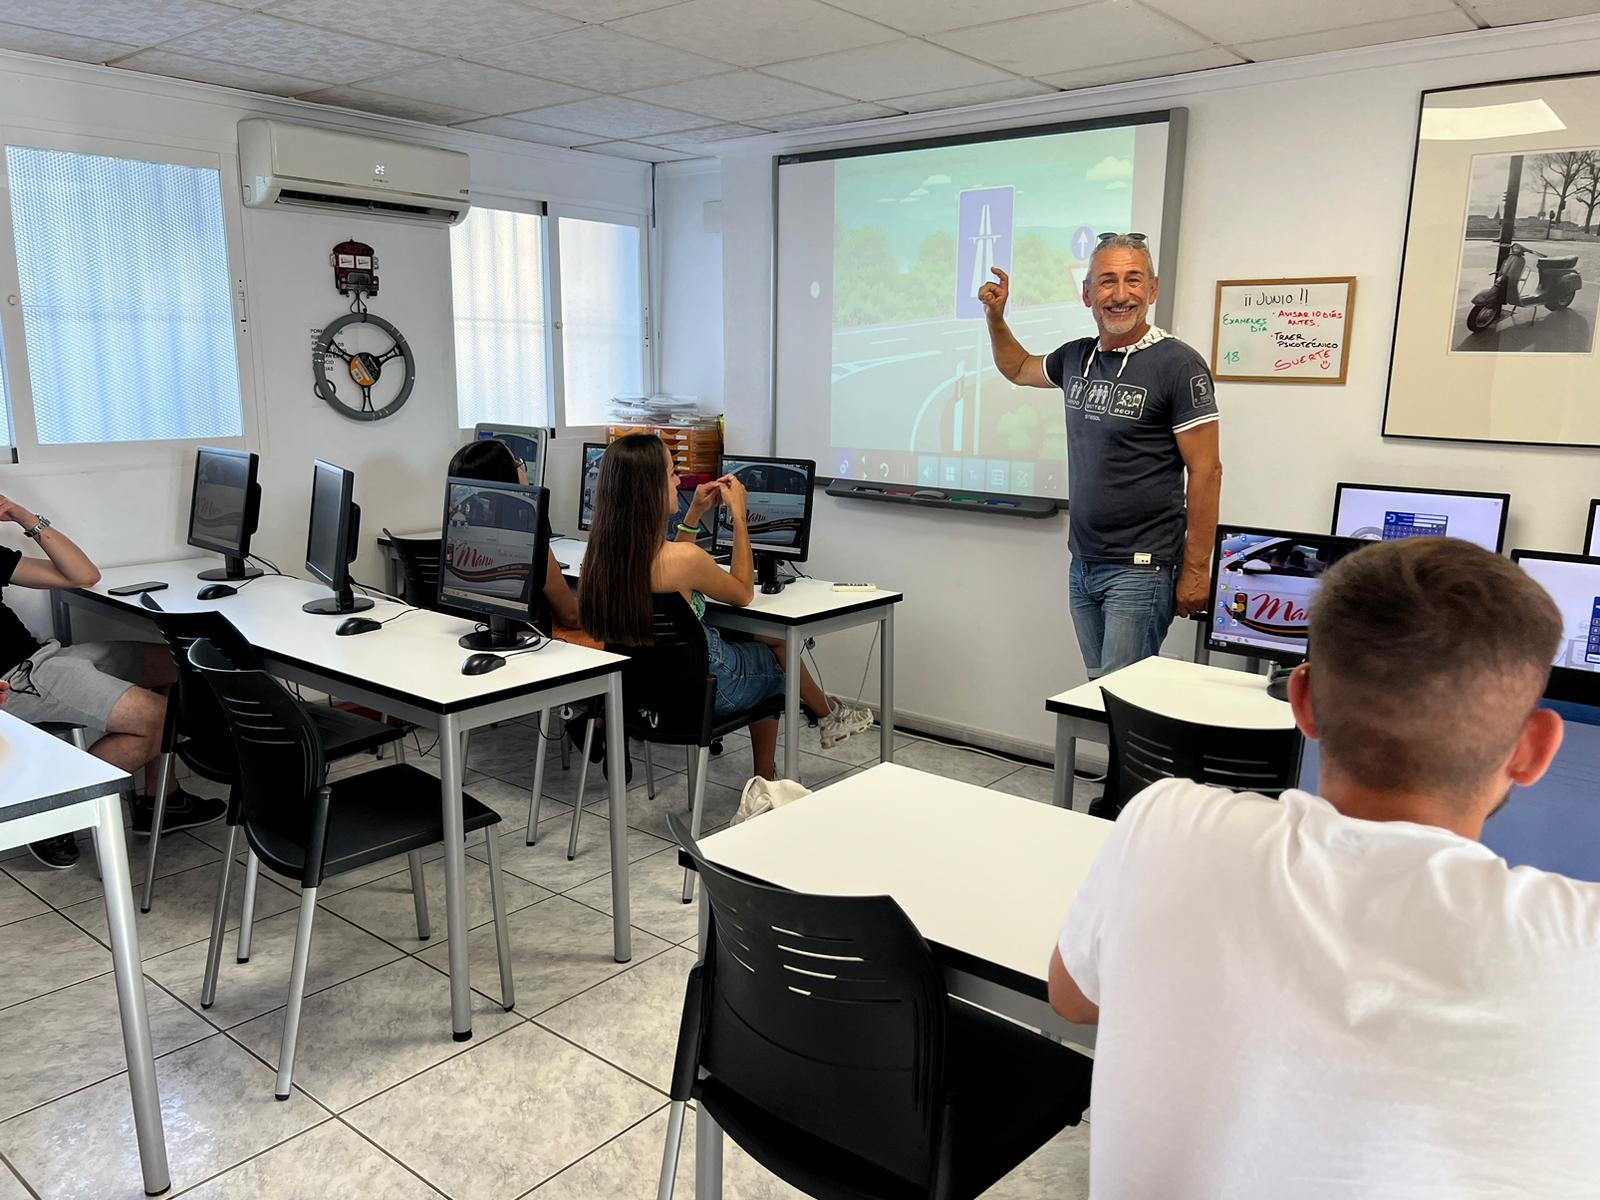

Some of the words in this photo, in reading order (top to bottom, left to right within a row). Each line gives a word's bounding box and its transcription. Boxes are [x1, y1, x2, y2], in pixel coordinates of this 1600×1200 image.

[1256, 292, 1293, 306] JUNIO
[1222, 313, 1267, 325] EXAMENES
[1278, 310, 1310, 318] AVISAR
[1250, 325, 1267, 333] DÍA
[1274, 331, 1305, 341] TRAER
[1276, 338, 1339, 349] PSICOTÉCNICO
[1224, 351, 1240, 365] 18
[1274, 349, 1331, 371] SUERTE
